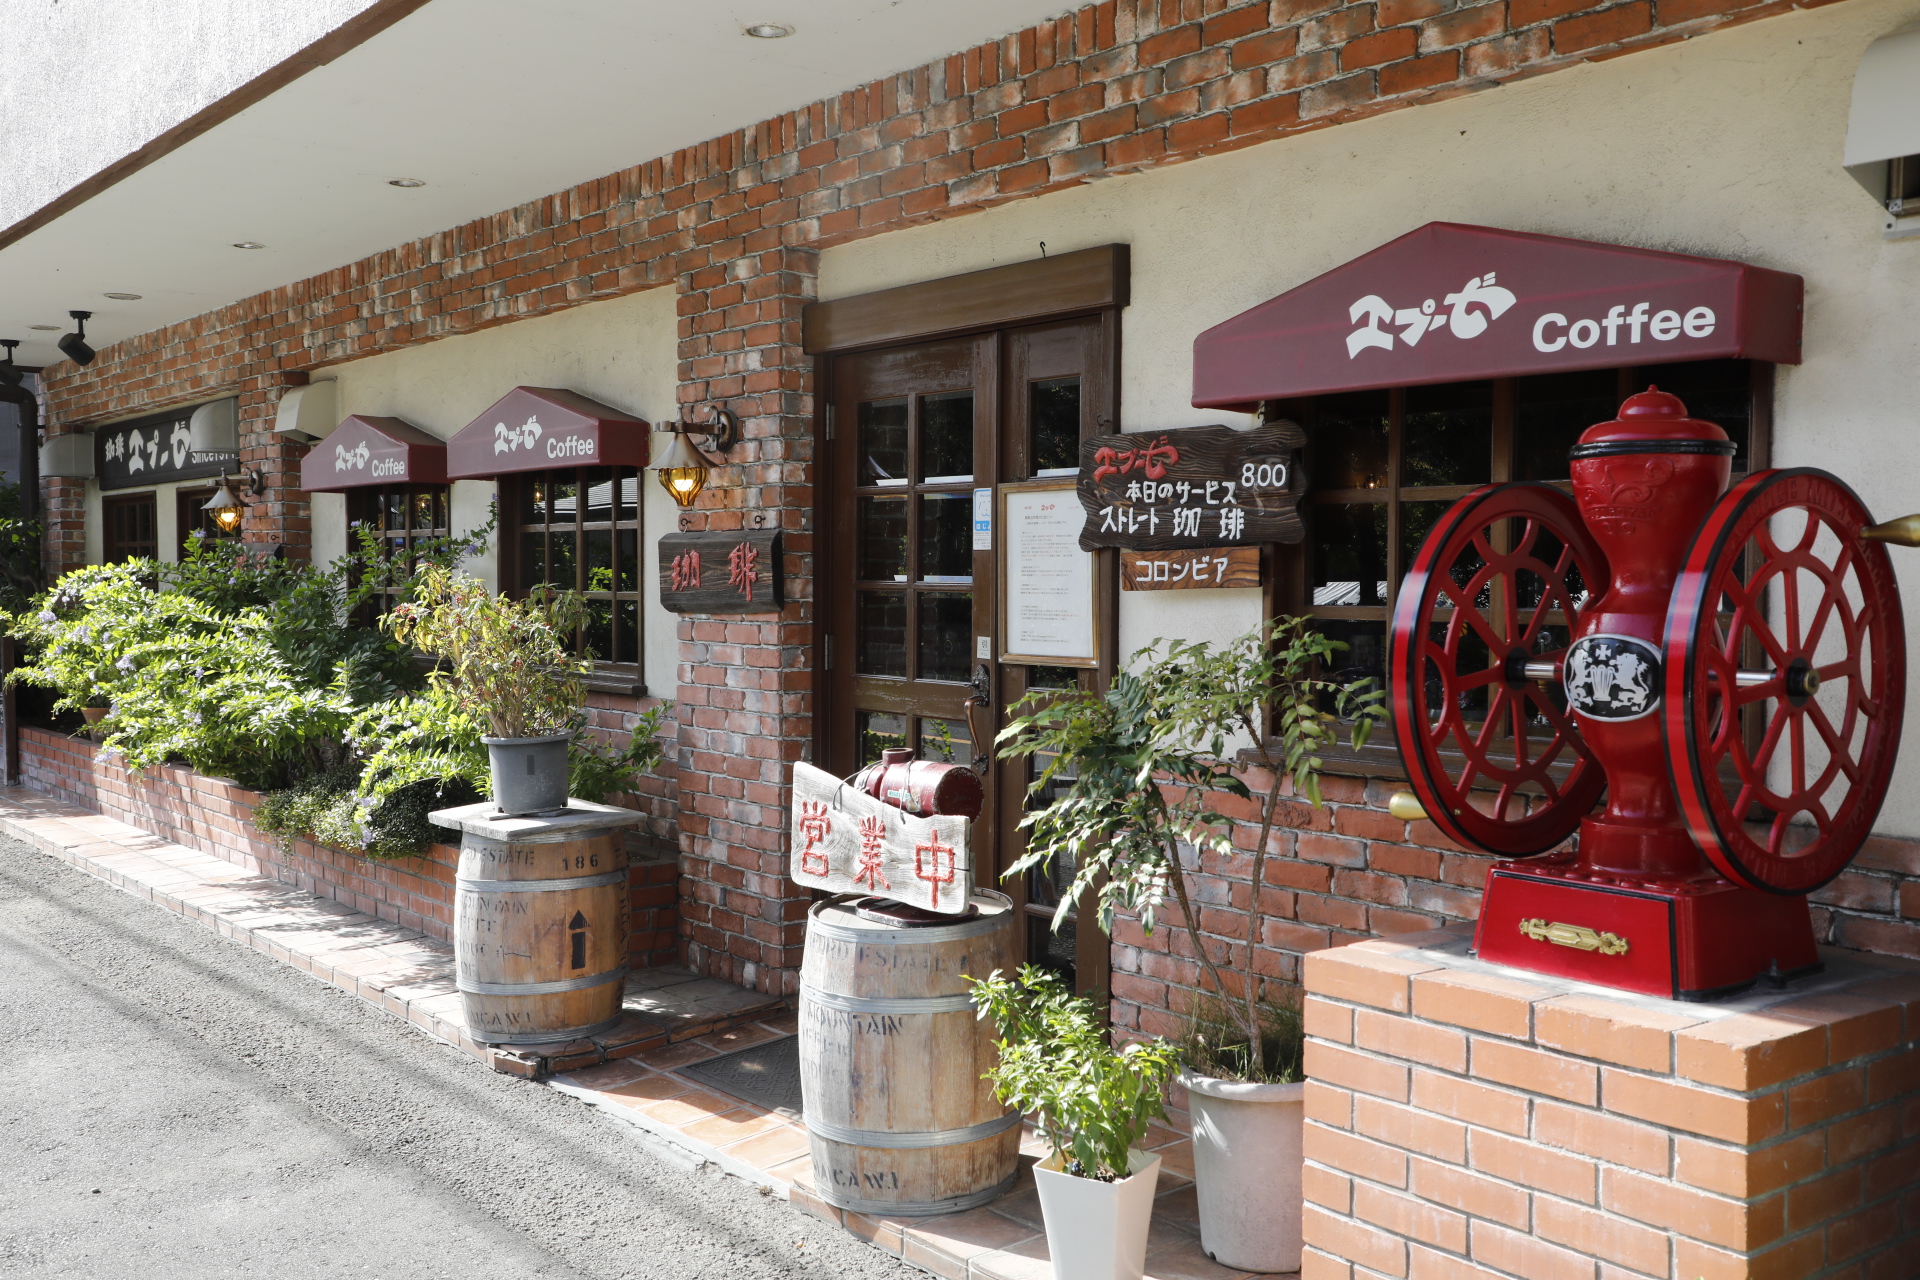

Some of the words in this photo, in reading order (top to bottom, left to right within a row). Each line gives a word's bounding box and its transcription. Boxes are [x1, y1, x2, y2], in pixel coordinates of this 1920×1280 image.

[1532, 302, 1716, 353] Coffee
[547, 435, 594, 459] Coffee
[372, 458, 405, 477] Coffee
[1241, 463, 1286, 488] 800
[1126, 480, 1238, 505] 本日のサービス
[1136, 556, 1228, 583] コロンビア
[800, 800, 955, 909] 営業中
